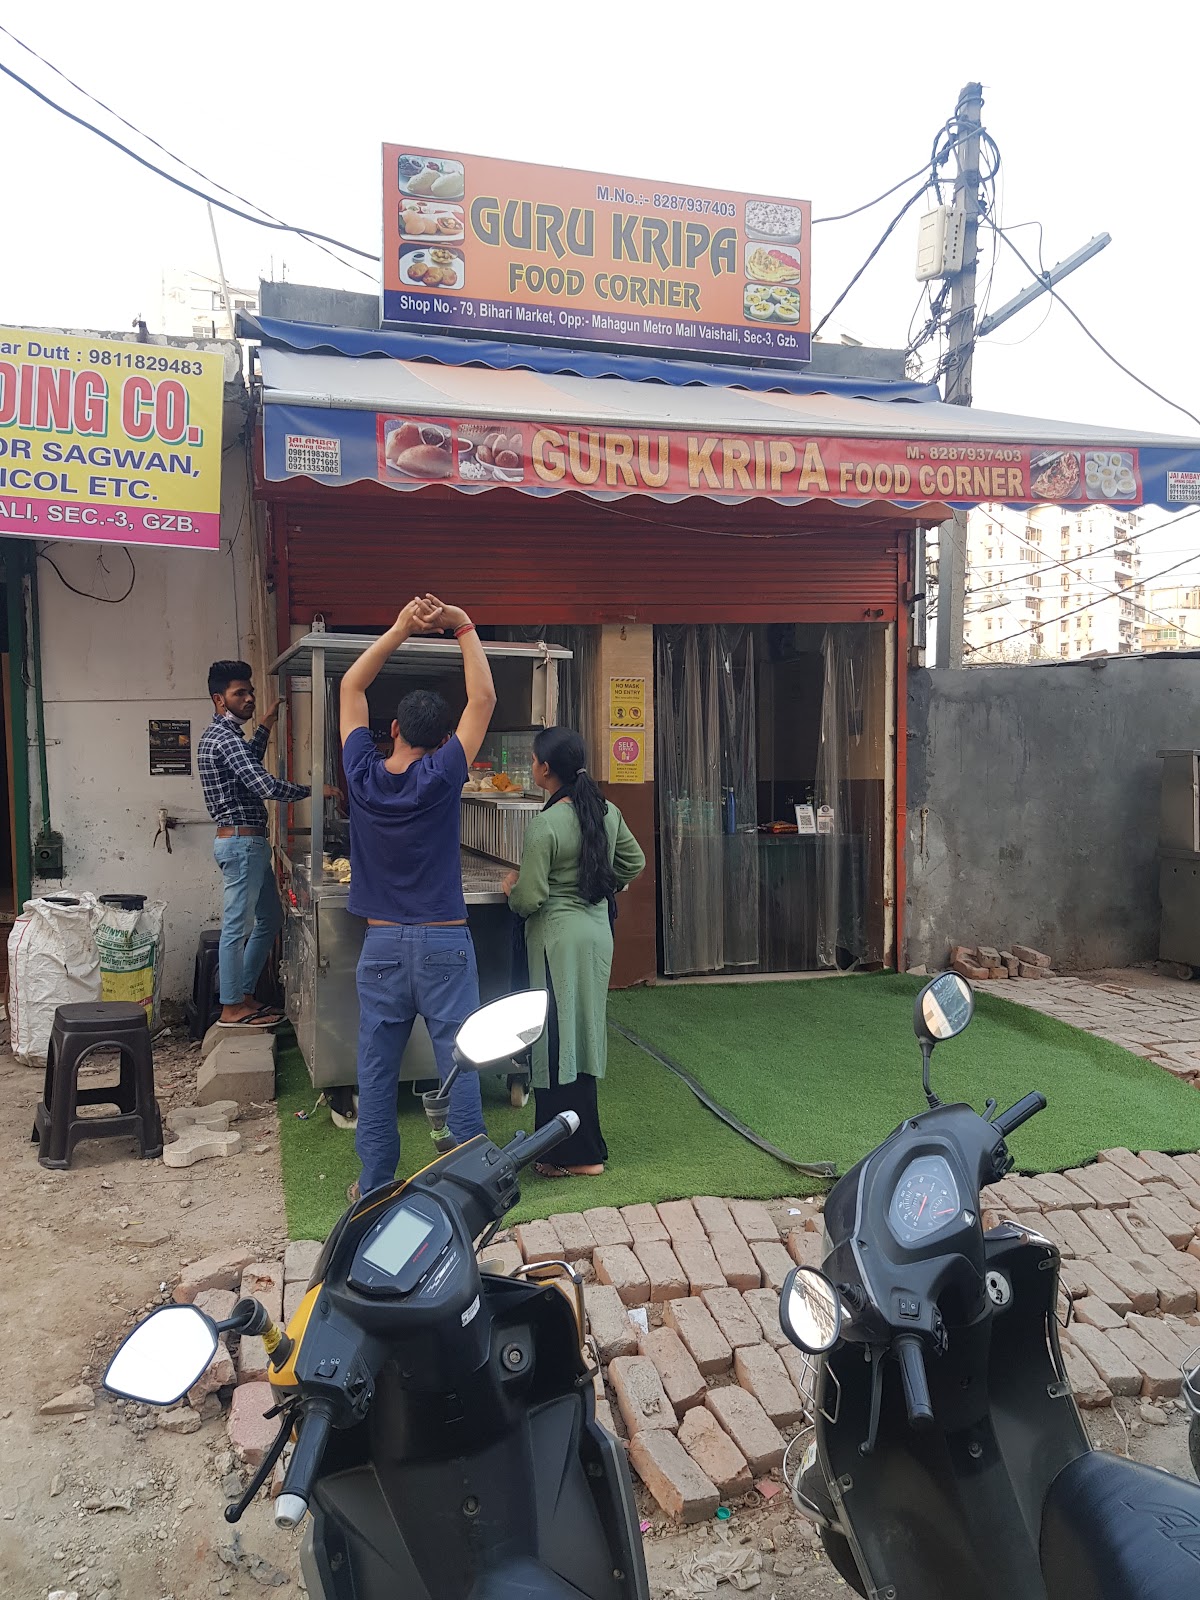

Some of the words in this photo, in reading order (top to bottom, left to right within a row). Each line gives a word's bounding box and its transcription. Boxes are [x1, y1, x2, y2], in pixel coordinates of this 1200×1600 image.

[597, 185, 650, 206] M.No.:-
[653, 193, 736, 217] 8287937403
[470, 196, 595, 260] GURU
[612, 212, 738, 278] KRIPA
[509, 262, 585, 296] FOOD
[594, 272, 702, 313] CORNER
[400, 295, 430, 315] Shop
[434, 298, 457, 314] No.-
[460, 301, 476, 318] 79,
[480, 303, 513, 320] Bihari
[516, 307, 556, 326] Market,
[559, 311, 589, 329] Opp:-
[592, 314, 640, 334] Mahagun
[644, 320, 672, 336] Metro
[676, 323, 696, 338] Mall
[699, 325, 740, 344] Vaishali,
[744, 330, 774, 347] Sec-3,
[777, 334, 799, 348] Gzb.
[28, 342, 70, 360] Dutt
[89, 349, 203, 376] 9811829483
[121, 375, 203, 446] CO.
[305, 438, 337, 446] AMBAY
[906, 446, 925, 460] M.
[930, 446, 1022, 462] 8287937403
[42, 442, 200, 478] SAGWAN,
[532, 428, 670, 488] GURU
[687, 436, 830, 493] KRIPA
[839, 462, 911, 496] FOOD
[920, 464, 1024, 497] CORNER
[0, 467, 78, 494] ICOL
[89, 476, 158, 500] ETC.
[47, 504, 134, 530] SEC.-3,
[142, 513, 200, 533] GZB.
